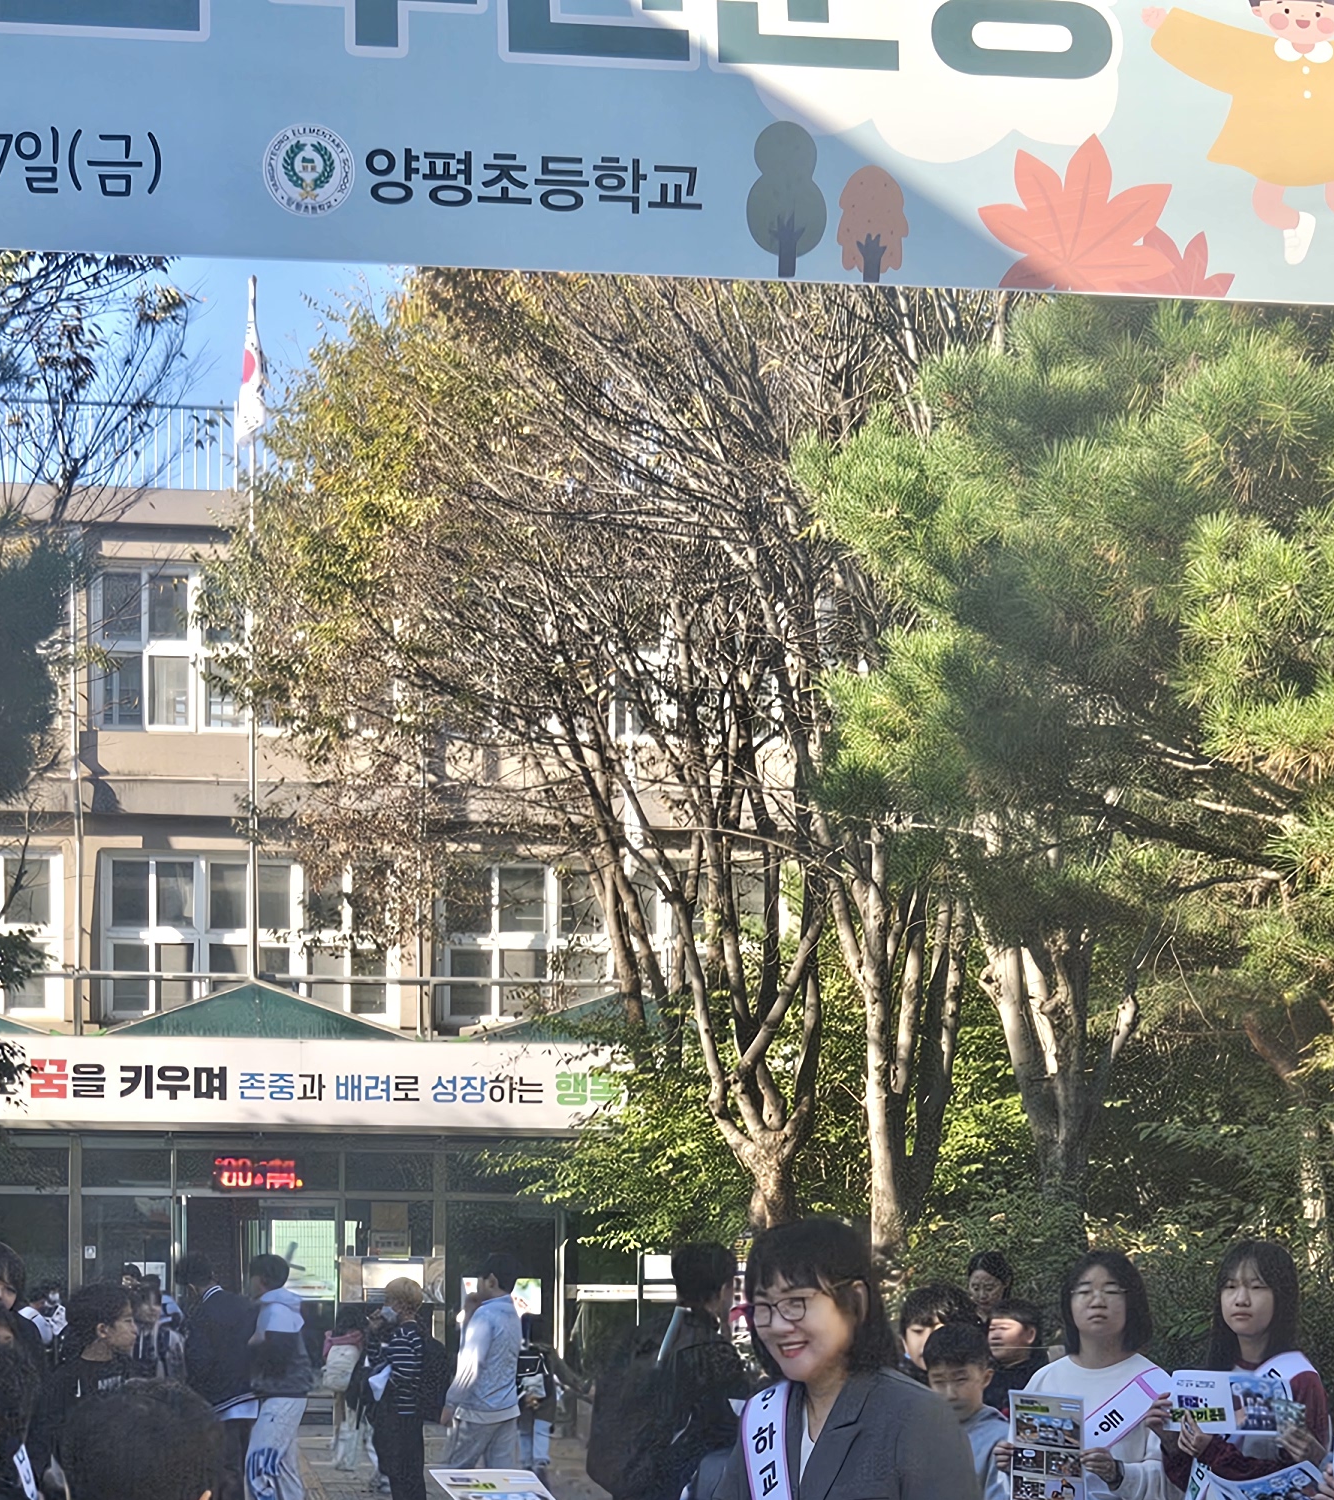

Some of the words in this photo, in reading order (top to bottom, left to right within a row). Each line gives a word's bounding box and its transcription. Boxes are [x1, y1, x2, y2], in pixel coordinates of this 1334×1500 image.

[361, 144, 704, 215] 양평초등학교
[30, 1058, 106, 1099] 꿈을
[118, 1063, 227, 1101] 키우며
[237, 1071, 326, 1103] 존중과
[333, 1073, 420, 1104] 배려로
[430, 1073, 544, 1105] 성장하는
